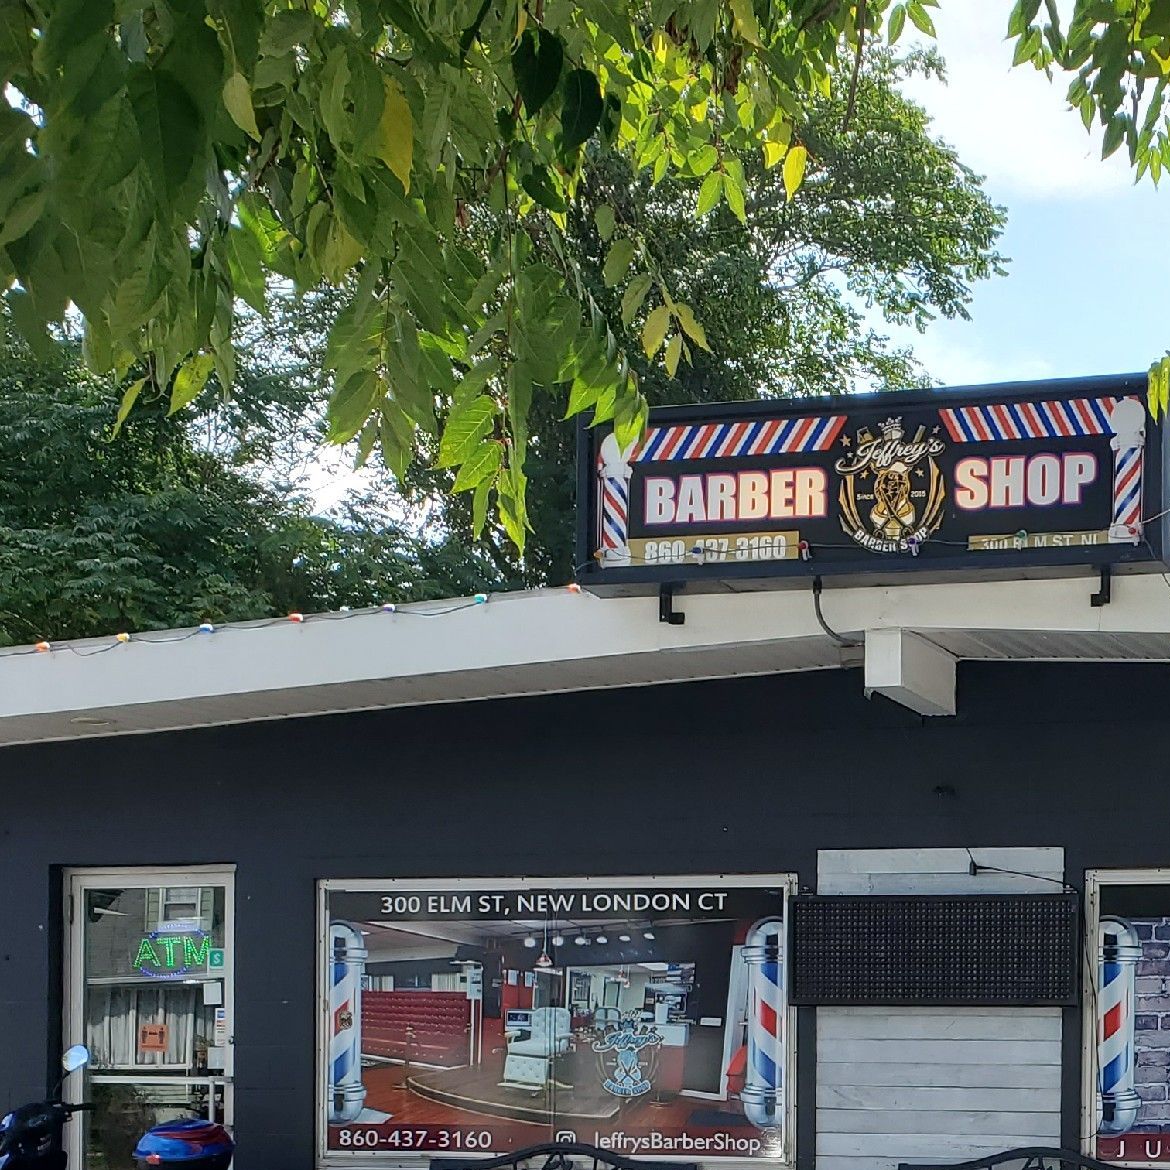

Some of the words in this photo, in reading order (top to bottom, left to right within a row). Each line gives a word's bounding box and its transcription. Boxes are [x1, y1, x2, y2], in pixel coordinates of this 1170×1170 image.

[834, 436, 946, 476] Jeffrey's
[644, 468, 828, 523] BARBER
[955, 453, 1097, 510] SHOP
[899, 527, 929, 551] SOP
[380, 895, 421, 914] 300
[427, 895, 471, 914] ELM
[478, 894, 509, 917] ST,
[517, 894, 575, 913] NEW
[581, 893, 692, 912] LONDON
[697, 892, 728, 911] CT
[133, 935, 213, 968] ATM
[339, 1129, 492, 1149] 860-437-3160
